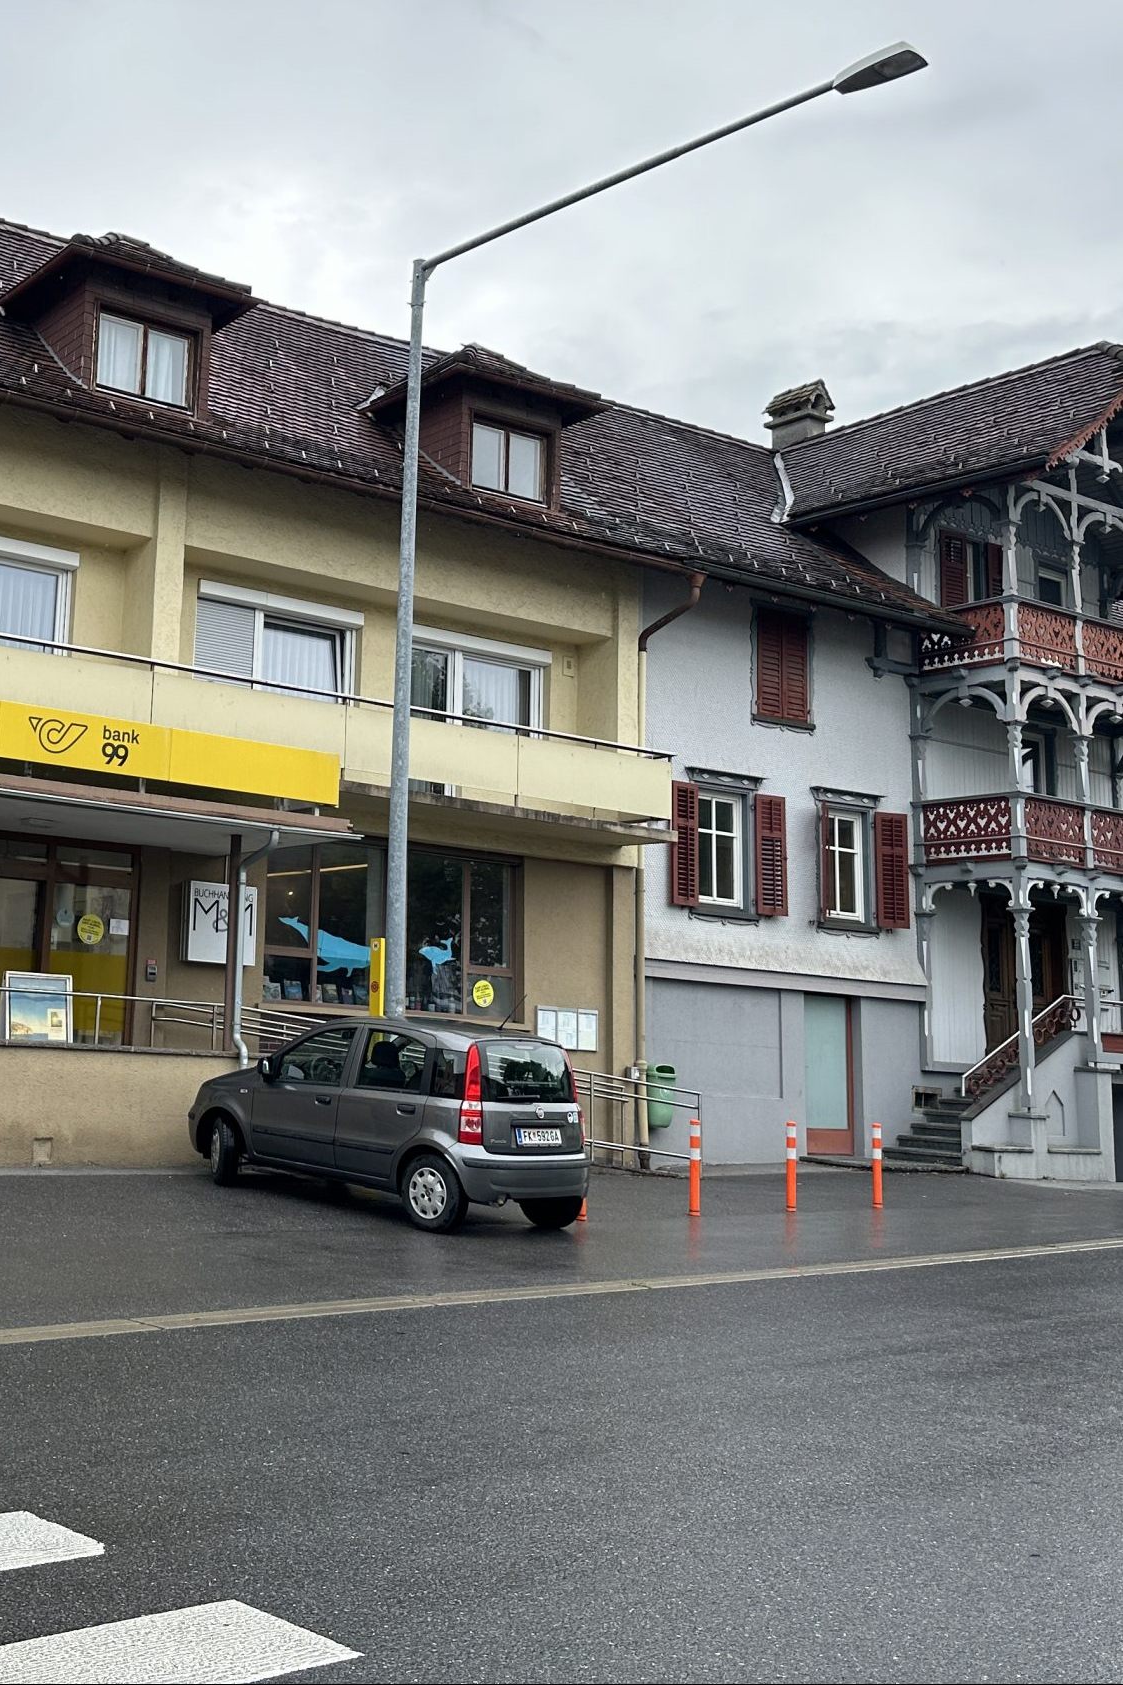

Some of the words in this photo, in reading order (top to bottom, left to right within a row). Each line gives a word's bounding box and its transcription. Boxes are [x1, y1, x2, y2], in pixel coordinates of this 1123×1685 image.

[102, 725, 140, 744] bank
[102, 742, 129, 767] 99
[523, 1130, 534, 1142] FK
